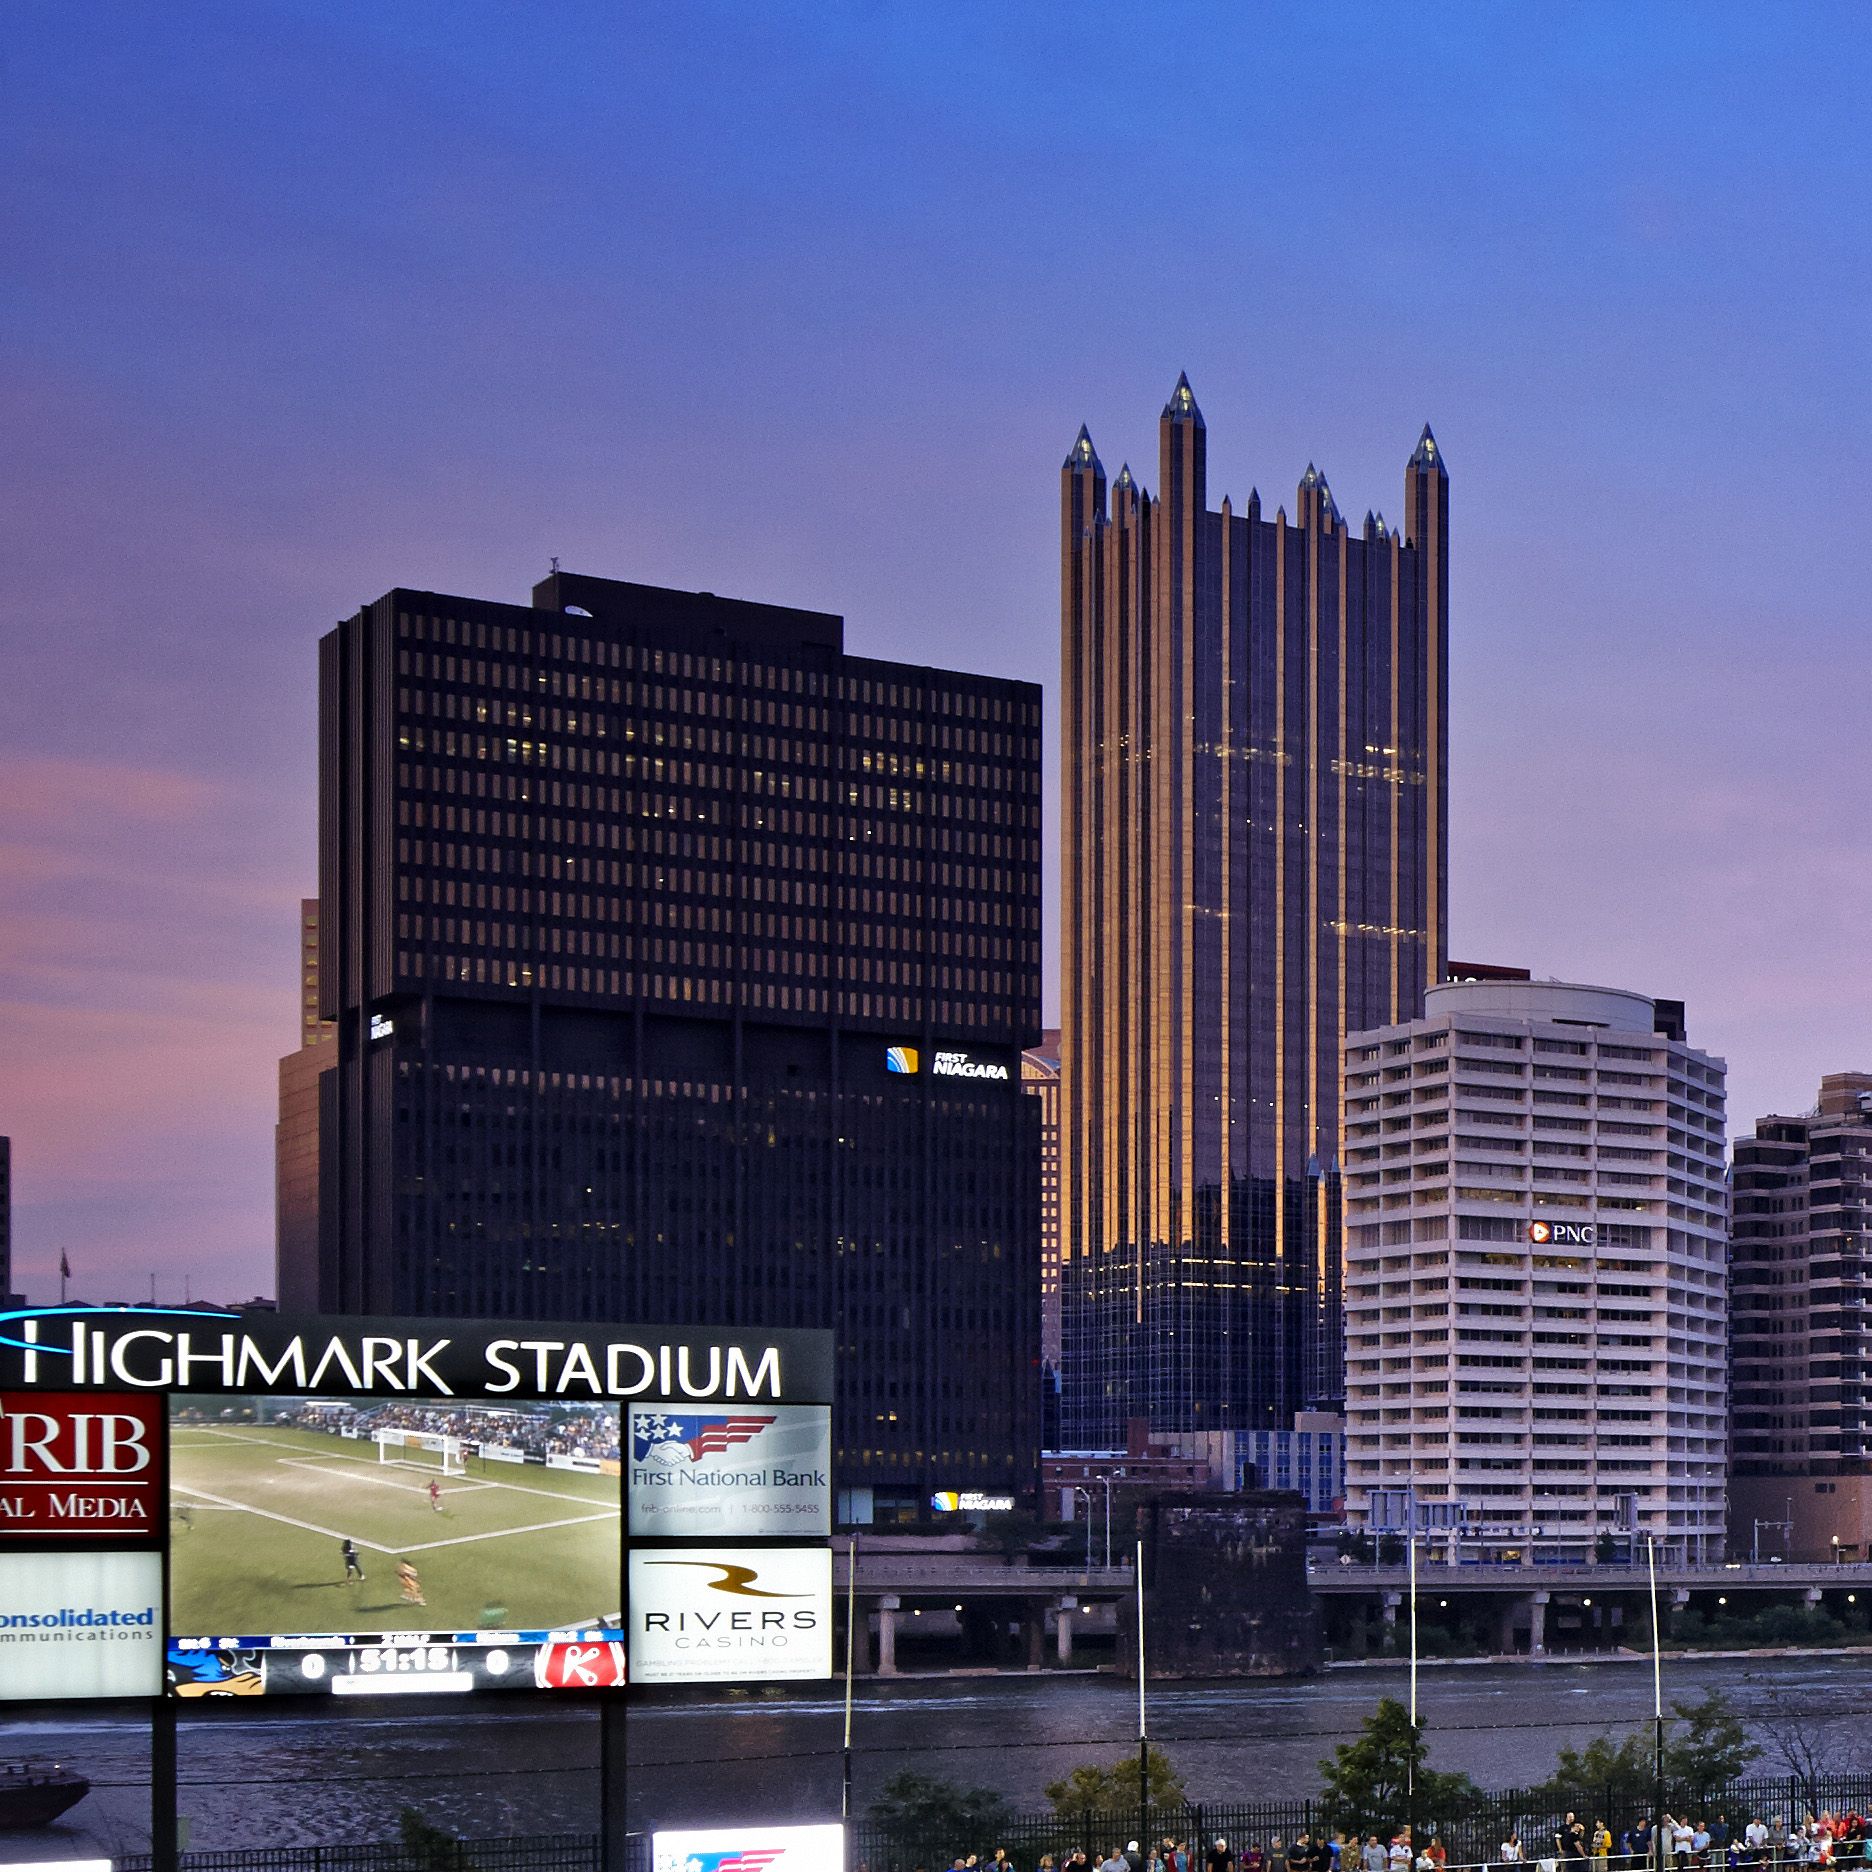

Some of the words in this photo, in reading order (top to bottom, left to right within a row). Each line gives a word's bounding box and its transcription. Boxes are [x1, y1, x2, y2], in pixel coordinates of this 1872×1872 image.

[934, 1052, 968, 1063] FIRST
[933, 1061, 1008, 1080] NIAGARA
[1553, 1225, 1593, 1243] PNC
[24, 1320, 455, 1396] HIGHMARK
[485, 1339, 781, 1397] STADIUM
[633, 1469, 673, 1486] First
[679, 1469, 767, 1487] National
[773, 1470, 826, 1487] Bank
[48, 1494, 148, 1518] MEDIA
[645, 1611, 817, 1631] RIVERS
[675, 1636, 788, 1649] CASINO
